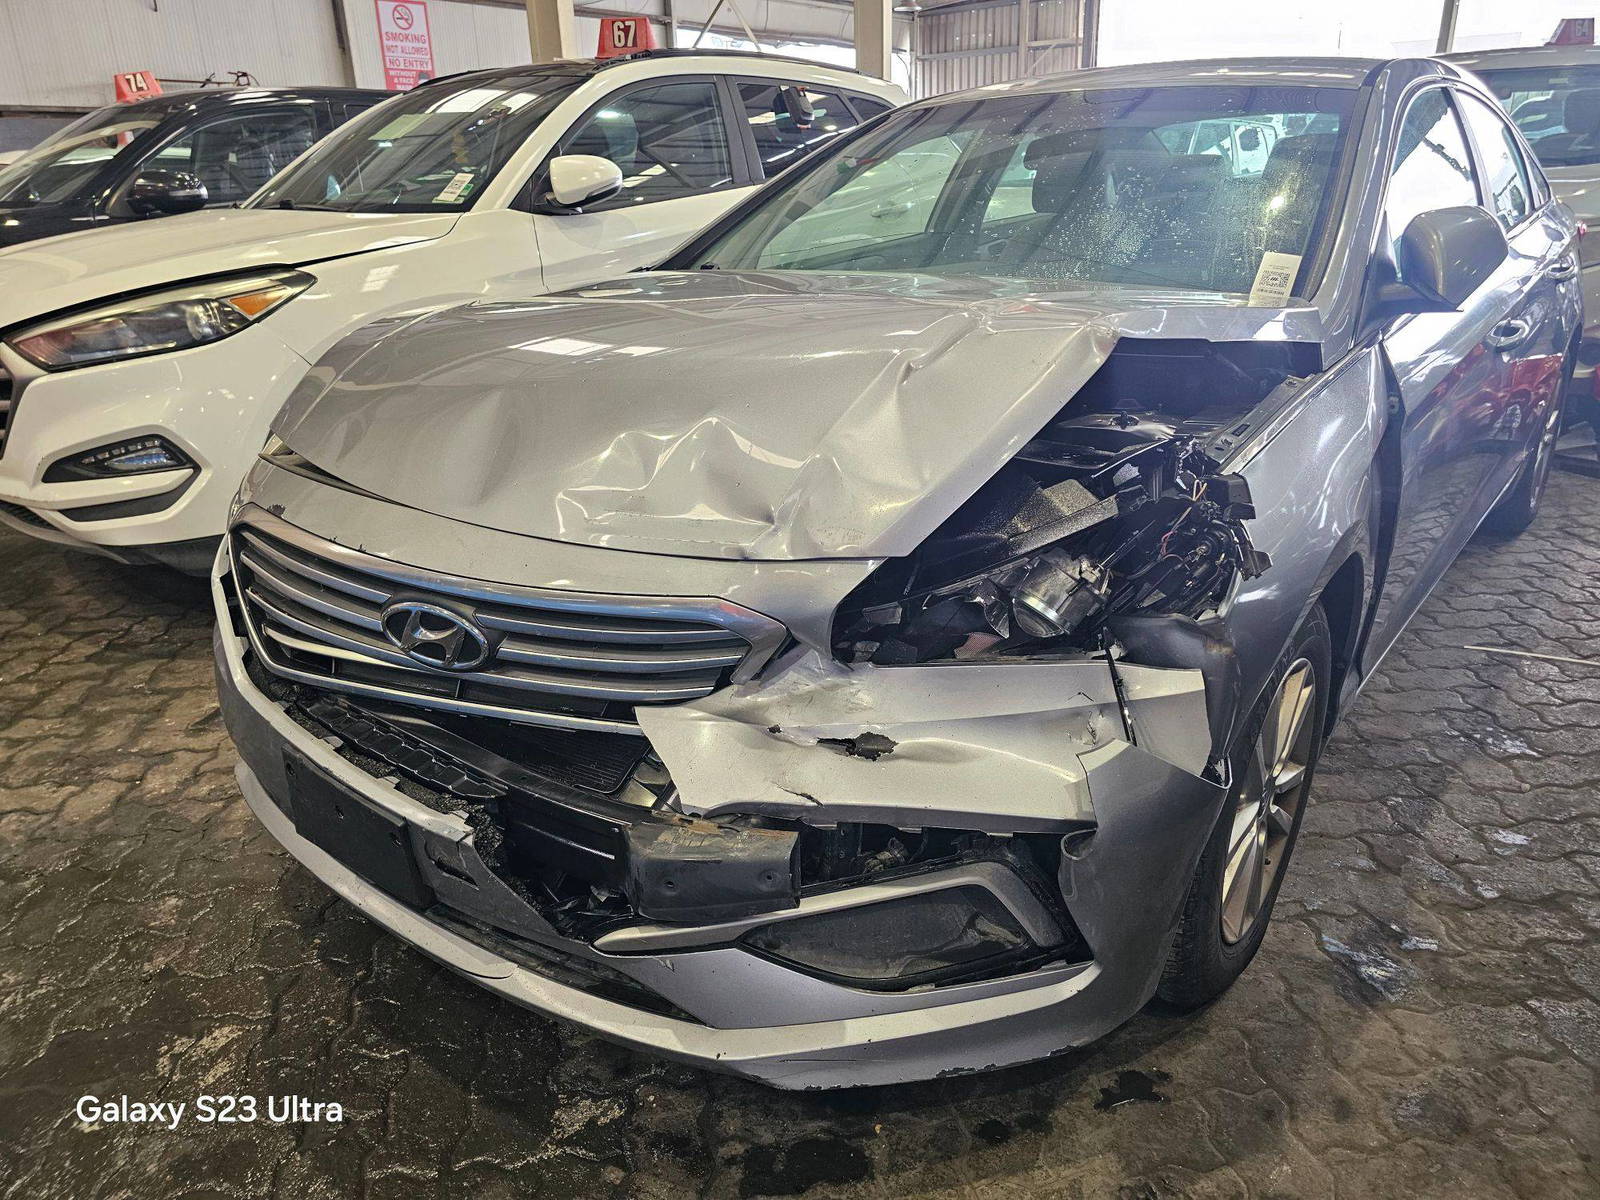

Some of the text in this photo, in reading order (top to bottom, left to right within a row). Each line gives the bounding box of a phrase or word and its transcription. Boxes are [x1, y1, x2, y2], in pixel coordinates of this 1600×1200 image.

[385, 31, 427, 44] SMOKING
[613, 20, 636, 48] 67
[400, 45, 429, 56] ALLOWED
[388, 58, 429, 69] NO ENTRY
[124, 72, 148, 92] 74
